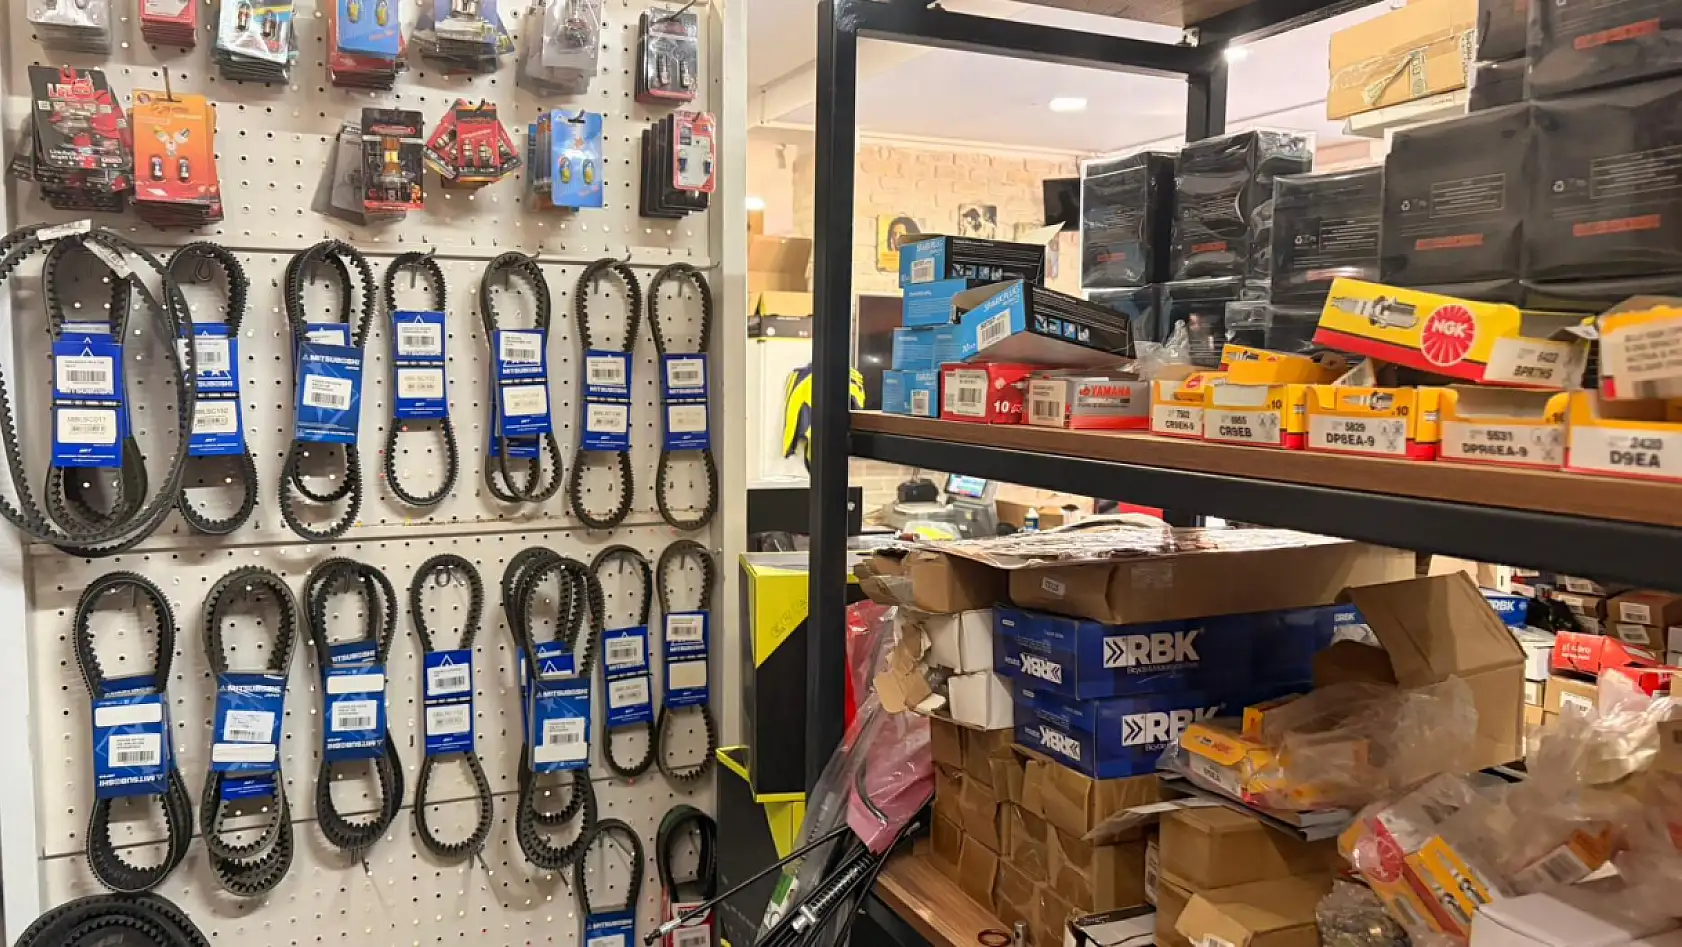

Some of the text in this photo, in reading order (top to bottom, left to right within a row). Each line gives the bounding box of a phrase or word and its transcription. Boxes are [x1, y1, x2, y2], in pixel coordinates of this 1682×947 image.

[1432, 319, 1468, 338] NGK
[1093, 385, 1132, 397] YAMAHA
[994, 401, 1010, 412] 10
[1344, 422, 1366, 432] 5829
[1325, 432, 1375, 447] DP8EA-9
[1609, 450, 1661, 469] D9EA
[1127, 630, 1200, 667] RBK
